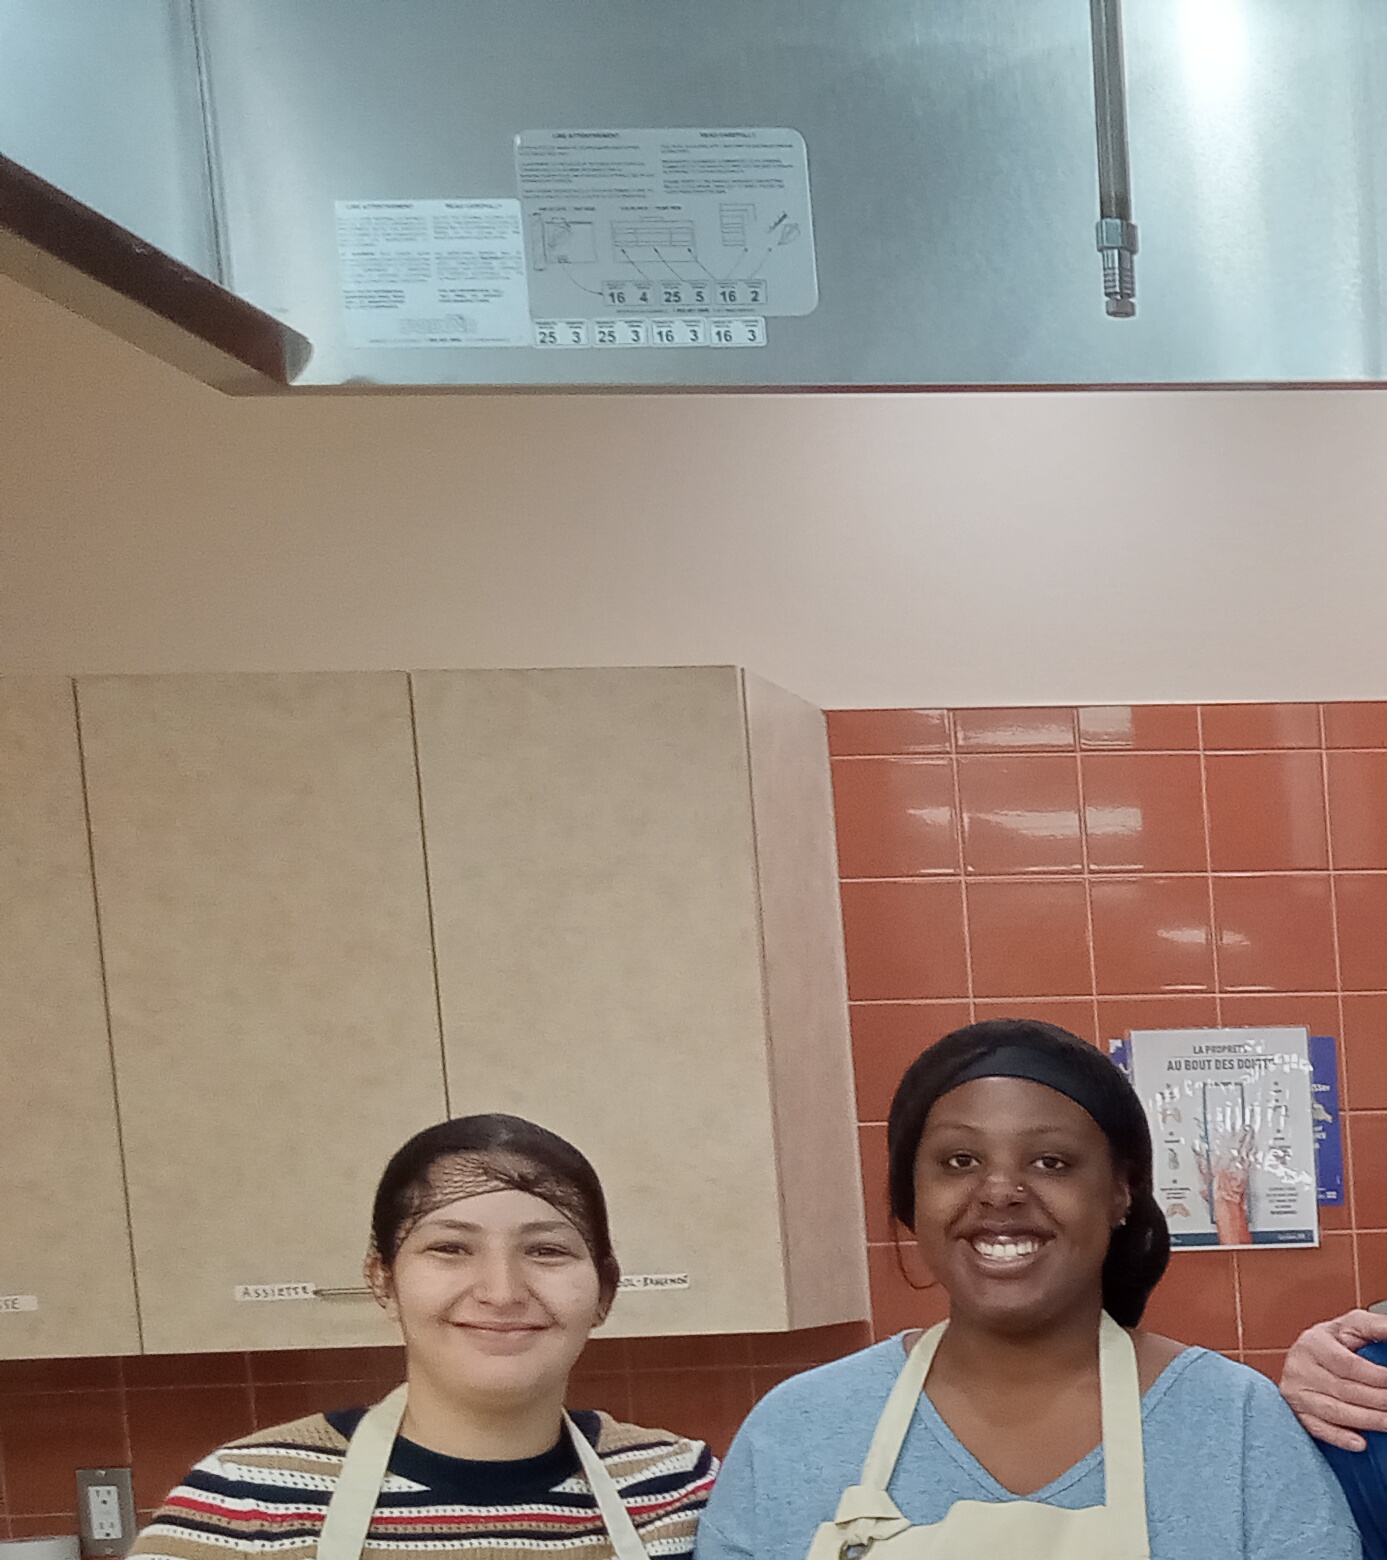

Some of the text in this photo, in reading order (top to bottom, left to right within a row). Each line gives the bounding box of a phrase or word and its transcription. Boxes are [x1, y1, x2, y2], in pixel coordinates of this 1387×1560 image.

[609, 291, 759, 303] 16 4 25 5 16 2
[538, 332, 581, 343] 25 3
[598, 330, 640, 342] 25 3
[657, 330, 699, 342] 16 3
[715, 329, 757, 342] 16 3
[1167, 1060, 1181, 1070] AU
[1185, 1059, 1212, 1070] BOUT
[1215, 1059, 1234, 1069] DES
